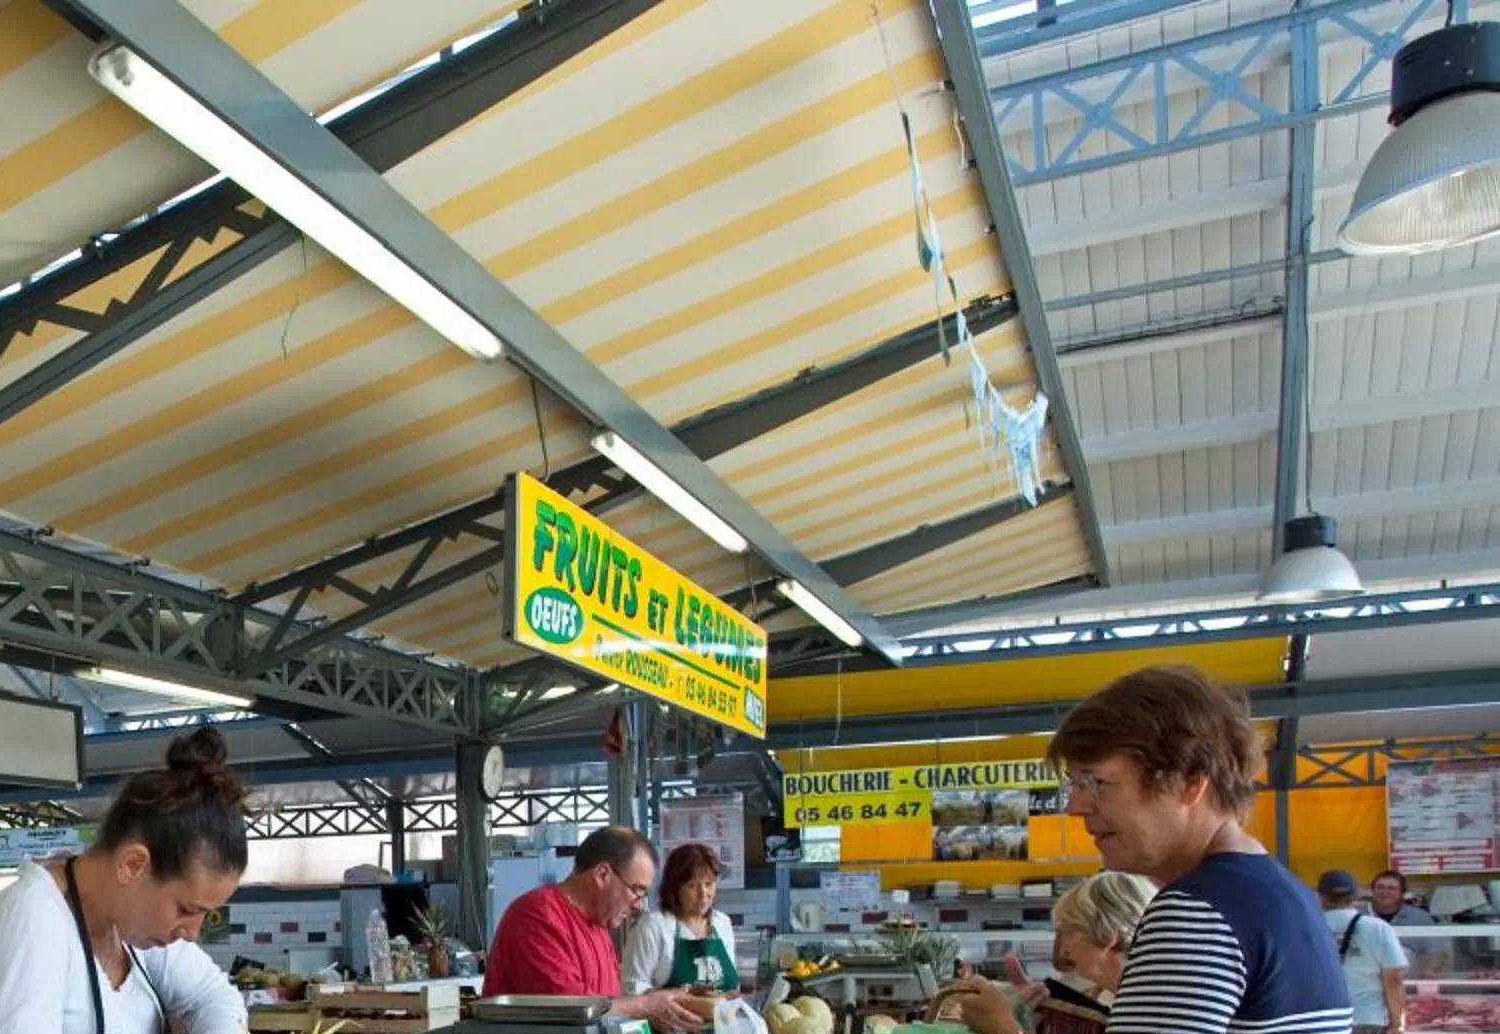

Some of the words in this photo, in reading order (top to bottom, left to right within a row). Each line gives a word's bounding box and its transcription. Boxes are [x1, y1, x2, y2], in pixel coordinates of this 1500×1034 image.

[532, 499, 642, 619] FRUITS
[647, 588, 669, 636] ET
[531, 594, 578, 638] OEUFS
[785, 770, 893, 796] BOUCHERIE
[794, 804, 821, 823] 05
[827, 803, 854, 821] 46
[860, 801, 887, 819] 84
[895, 800, 923, 818] 47
